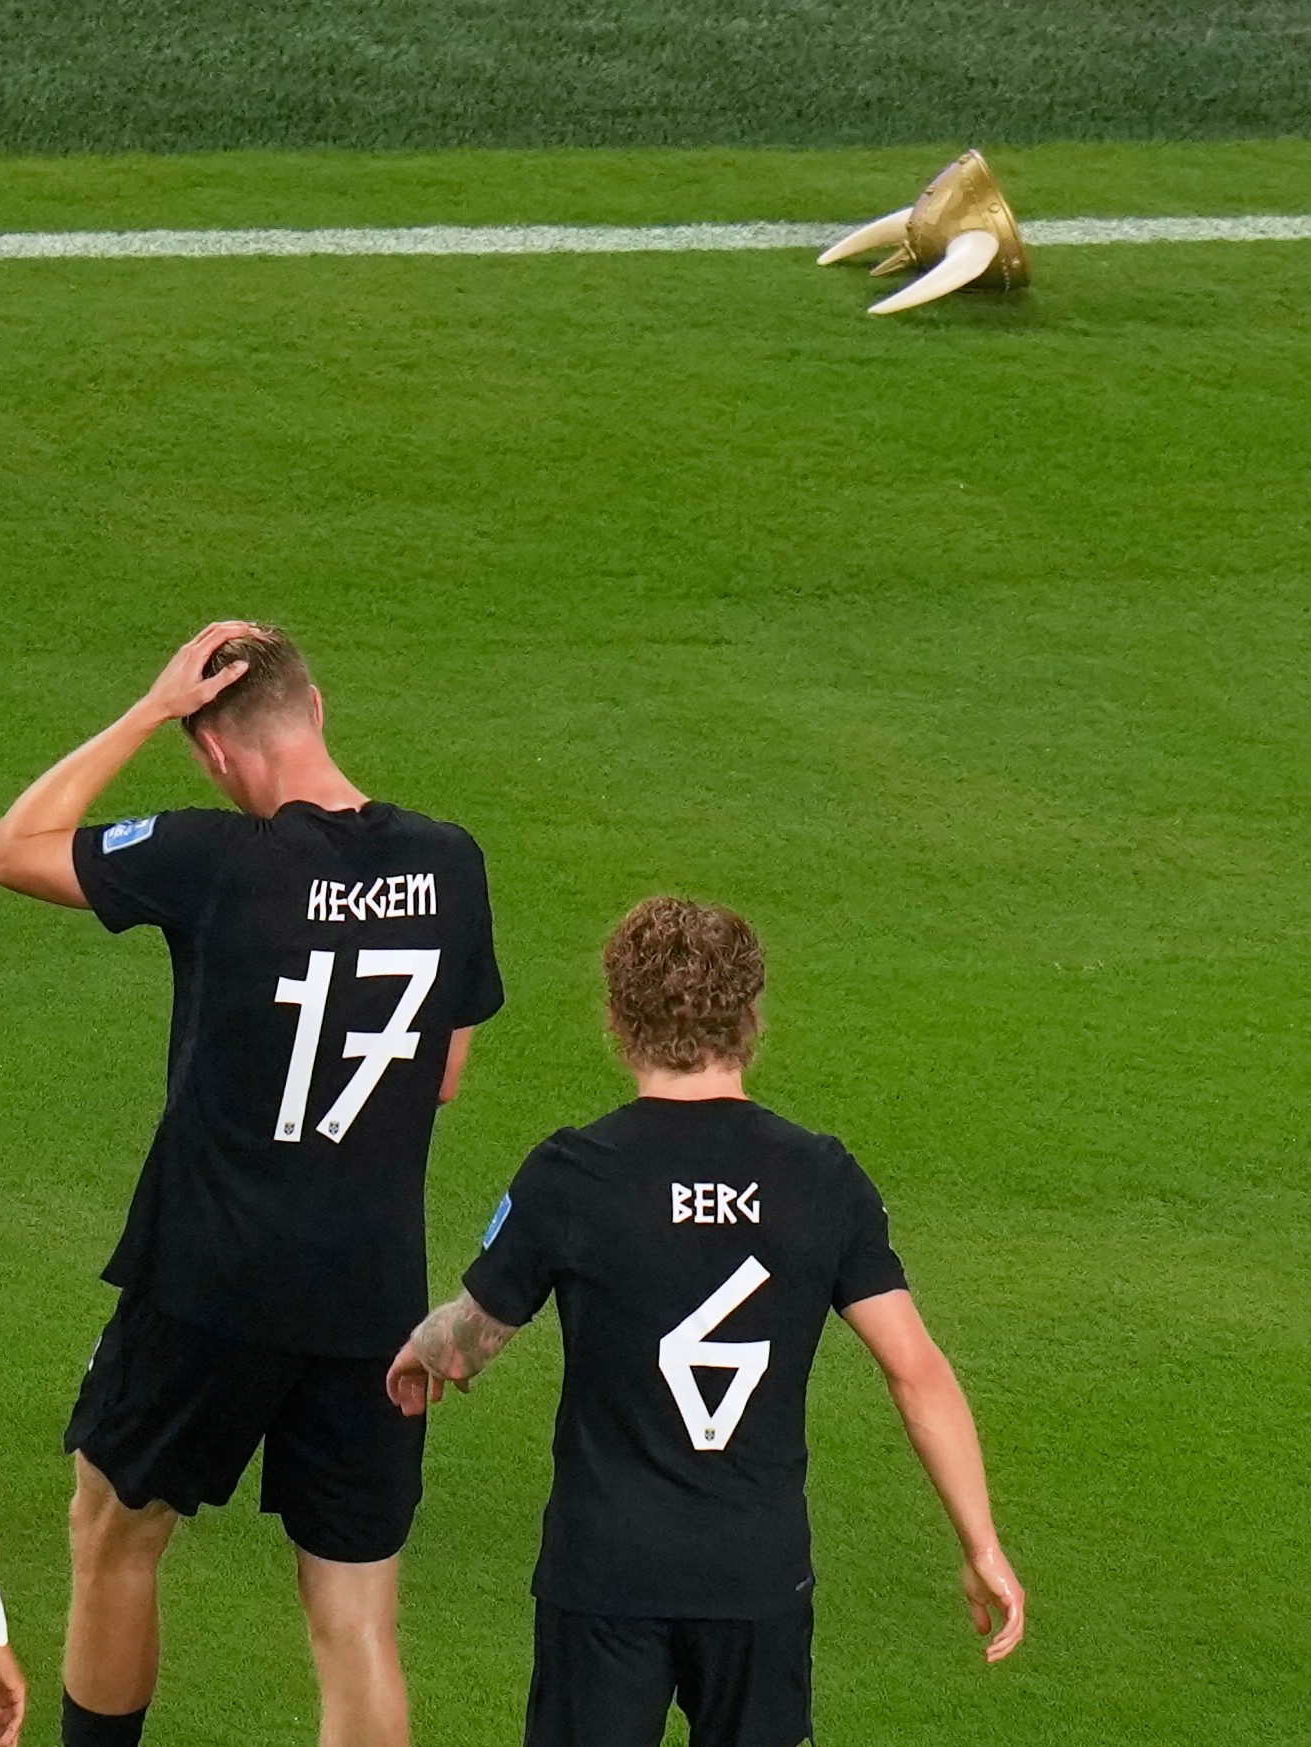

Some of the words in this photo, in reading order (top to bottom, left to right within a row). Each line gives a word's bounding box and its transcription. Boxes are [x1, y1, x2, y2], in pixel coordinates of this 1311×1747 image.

[307, 873, 437, 922] HEGGEM
[274, 949, 441, 1144] 17
[671, 1181, 761, 1224] BERG
[659, 1255, 771, 1451] 6
